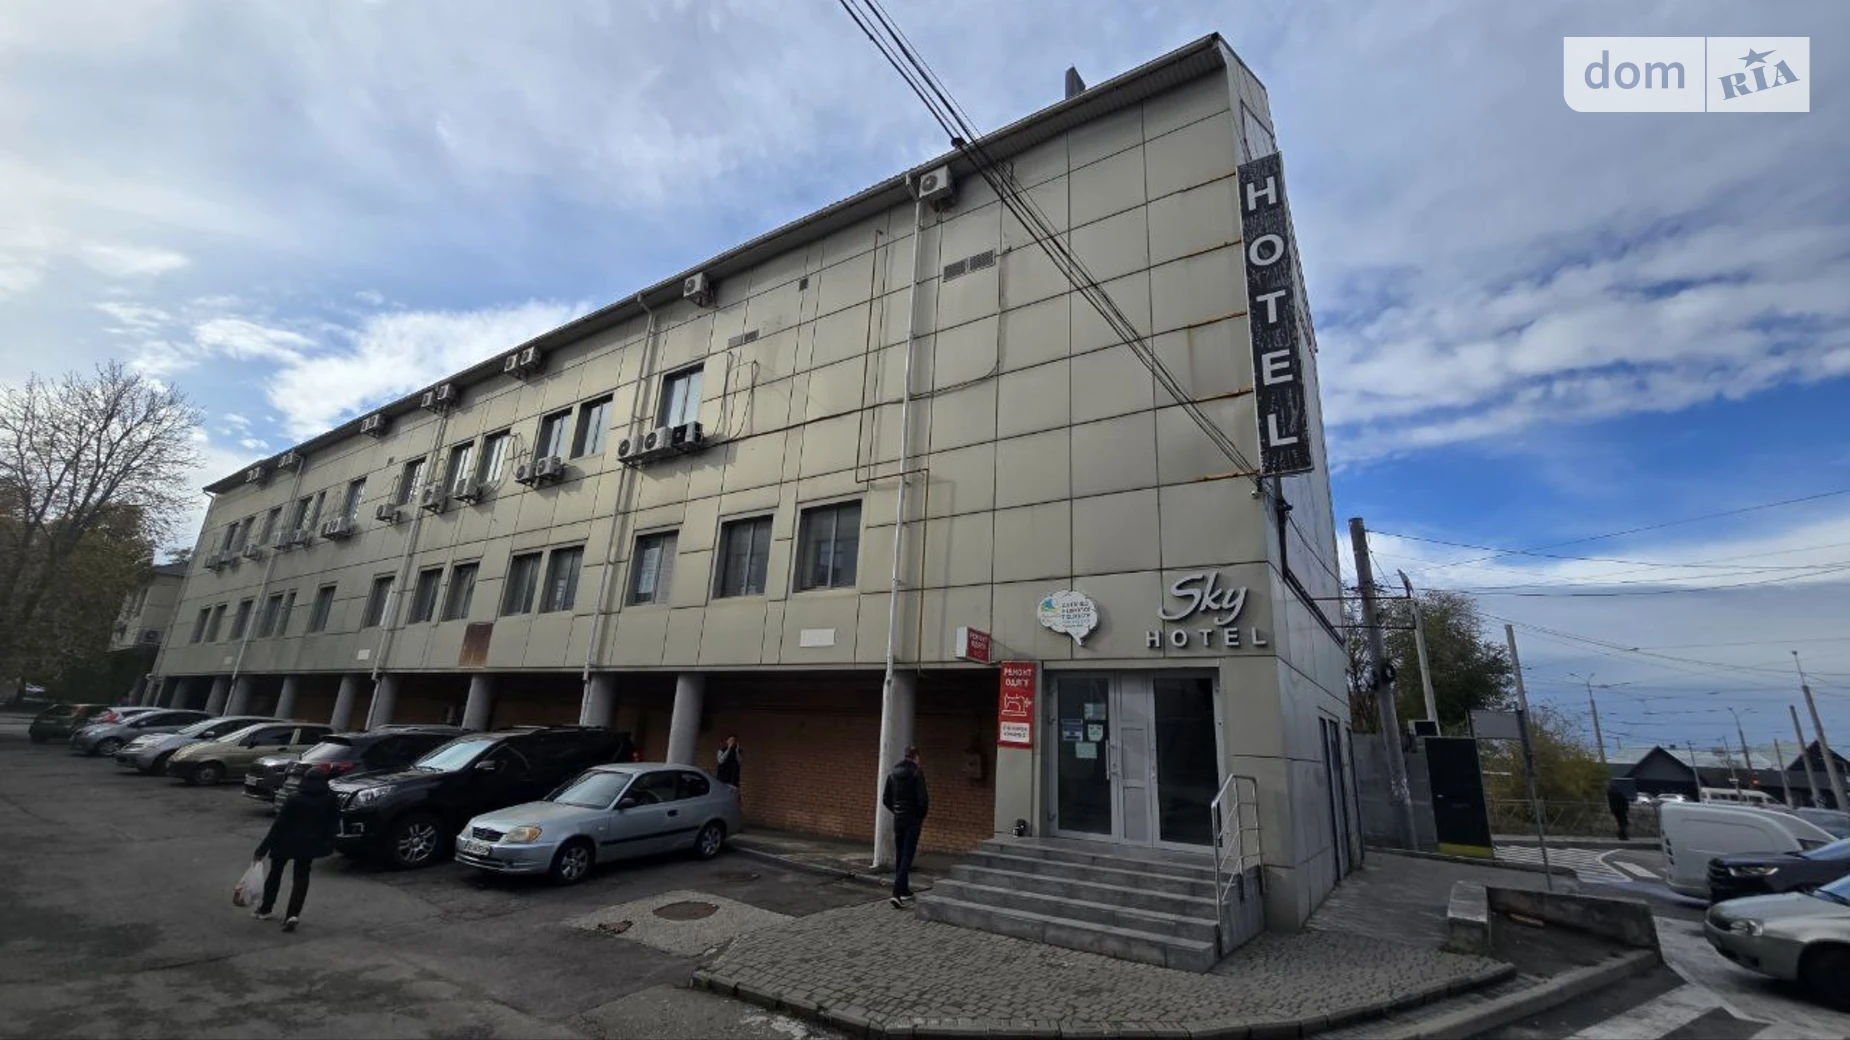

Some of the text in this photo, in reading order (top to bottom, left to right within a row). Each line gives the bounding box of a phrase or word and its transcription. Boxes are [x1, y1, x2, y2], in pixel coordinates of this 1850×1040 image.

[1247, 176, 1299, 448] HOTEL
[1158, 570, 1248, 626] Sky
[1145, 627, 1267, 648] HOTEL
